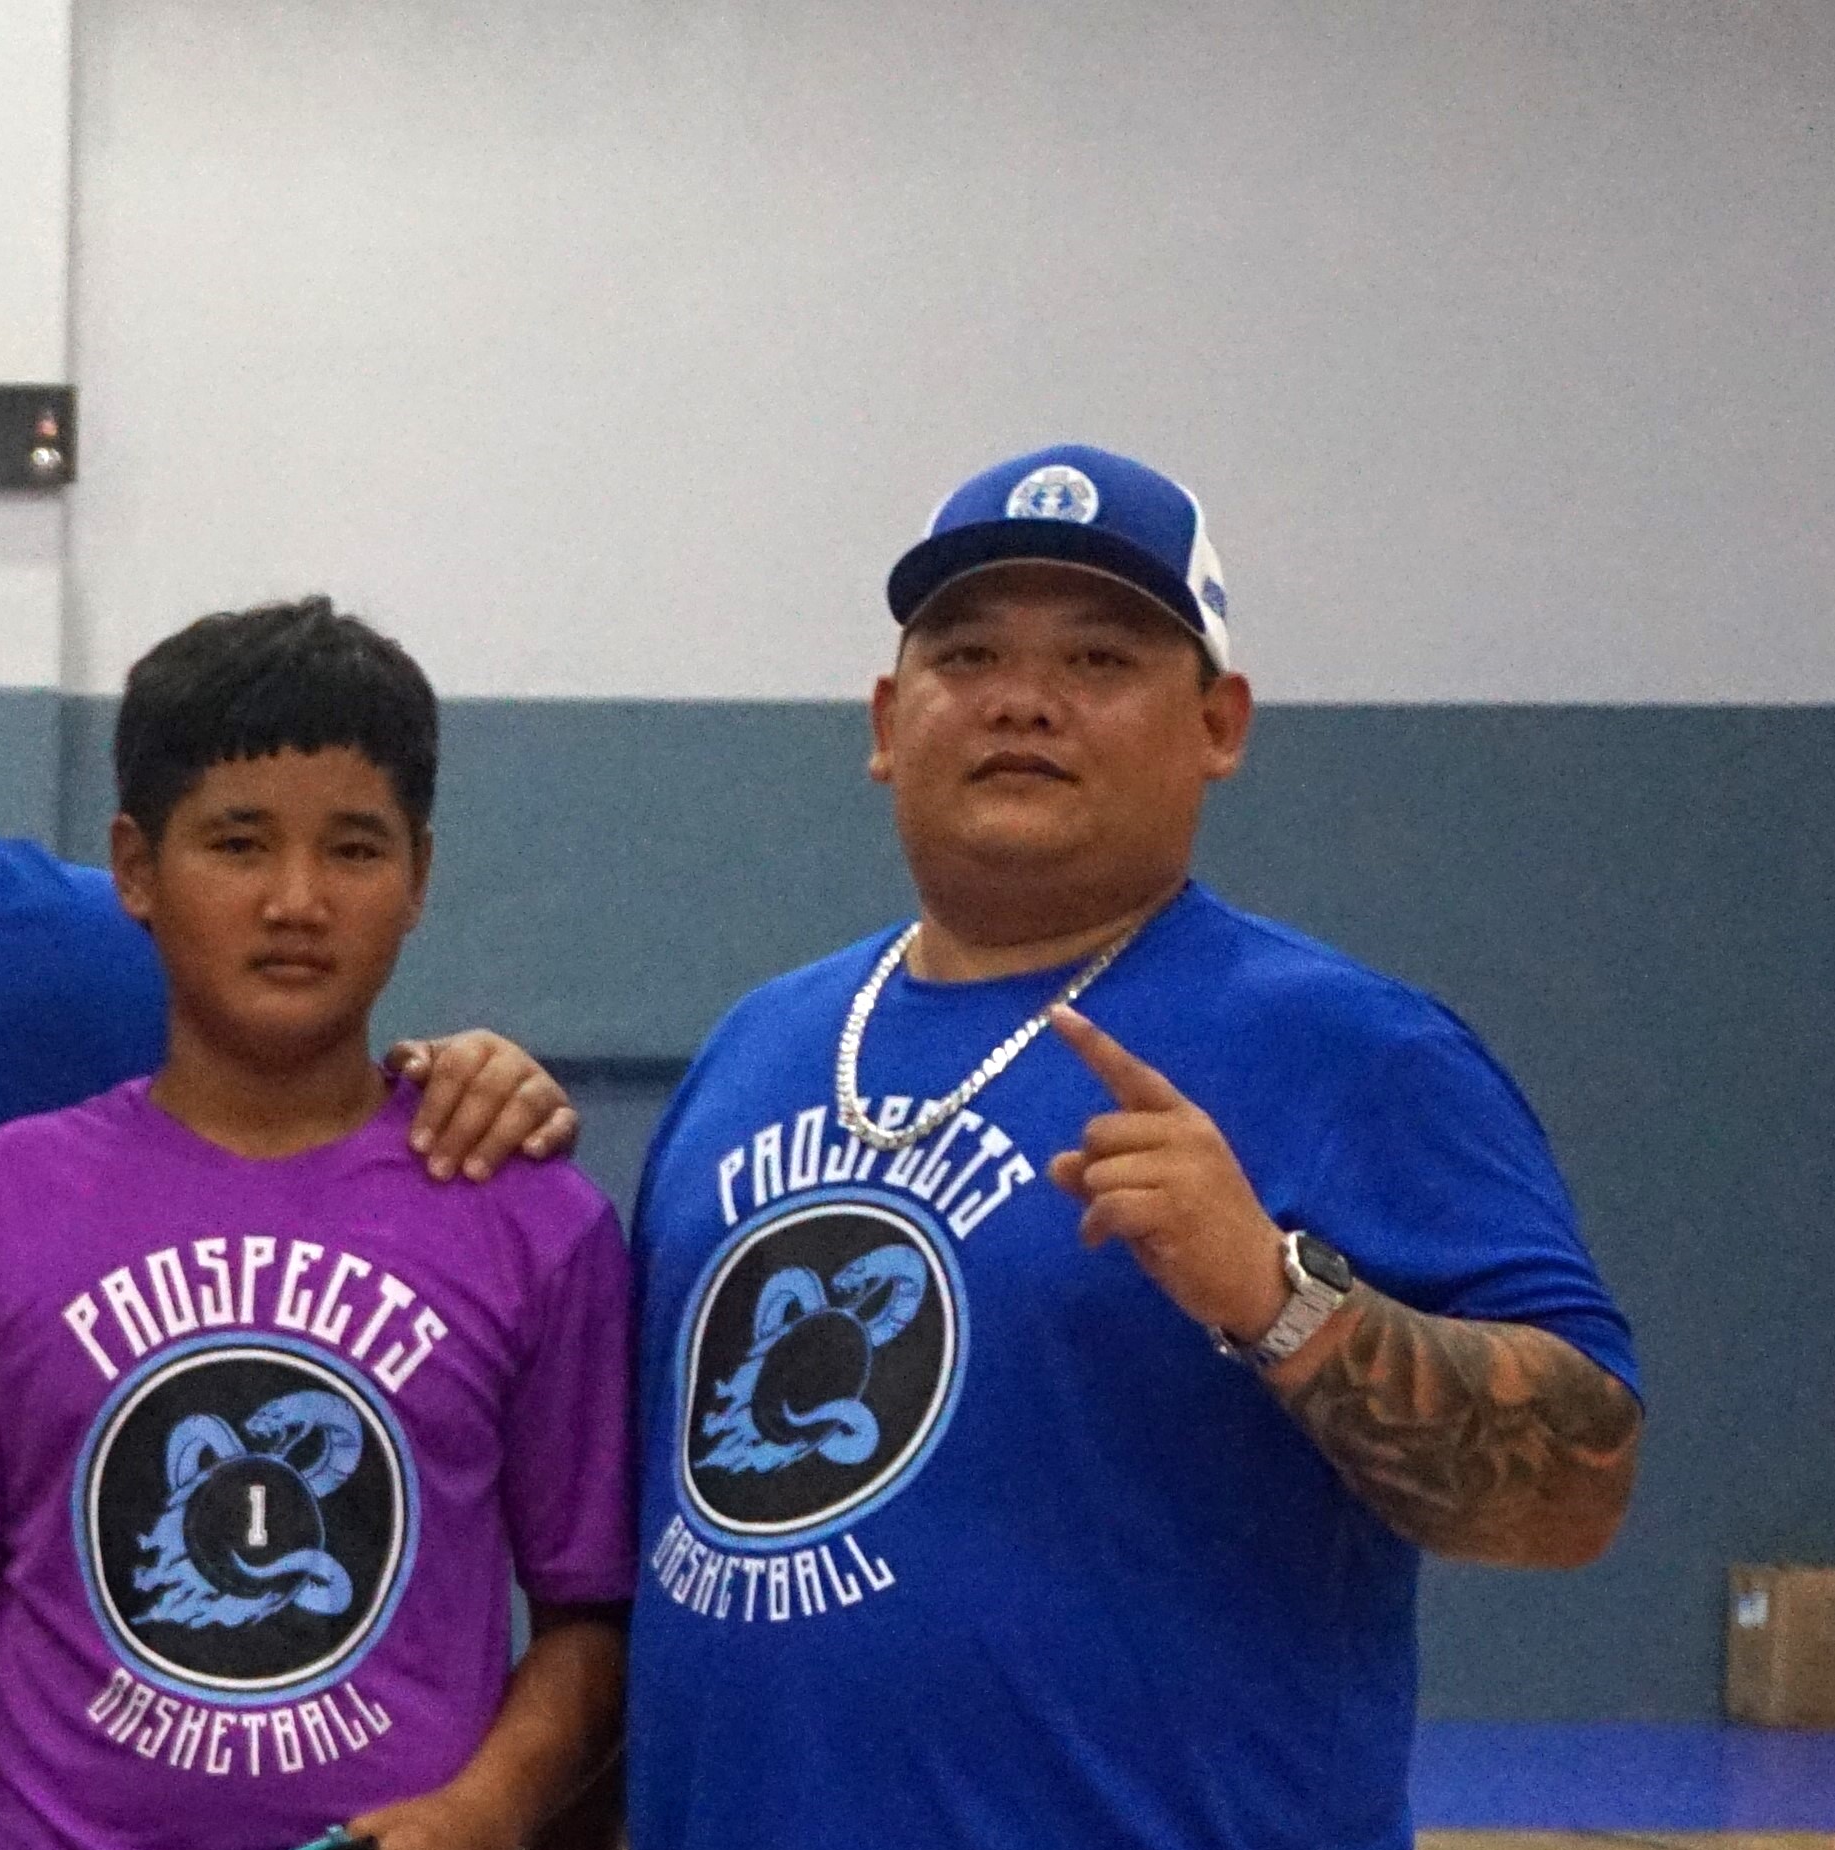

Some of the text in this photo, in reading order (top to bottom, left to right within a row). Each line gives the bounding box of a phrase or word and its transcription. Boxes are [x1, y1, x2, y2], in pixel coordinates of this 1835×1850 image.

[717, 1095, 1036, 1240] PROSPECTS
[62, 1235, 449, 1393] PROSPECTS
[652, 1514, 896, 1622] BASKETBALL
[87, 1667, 394, 1776] BASKETBALL
